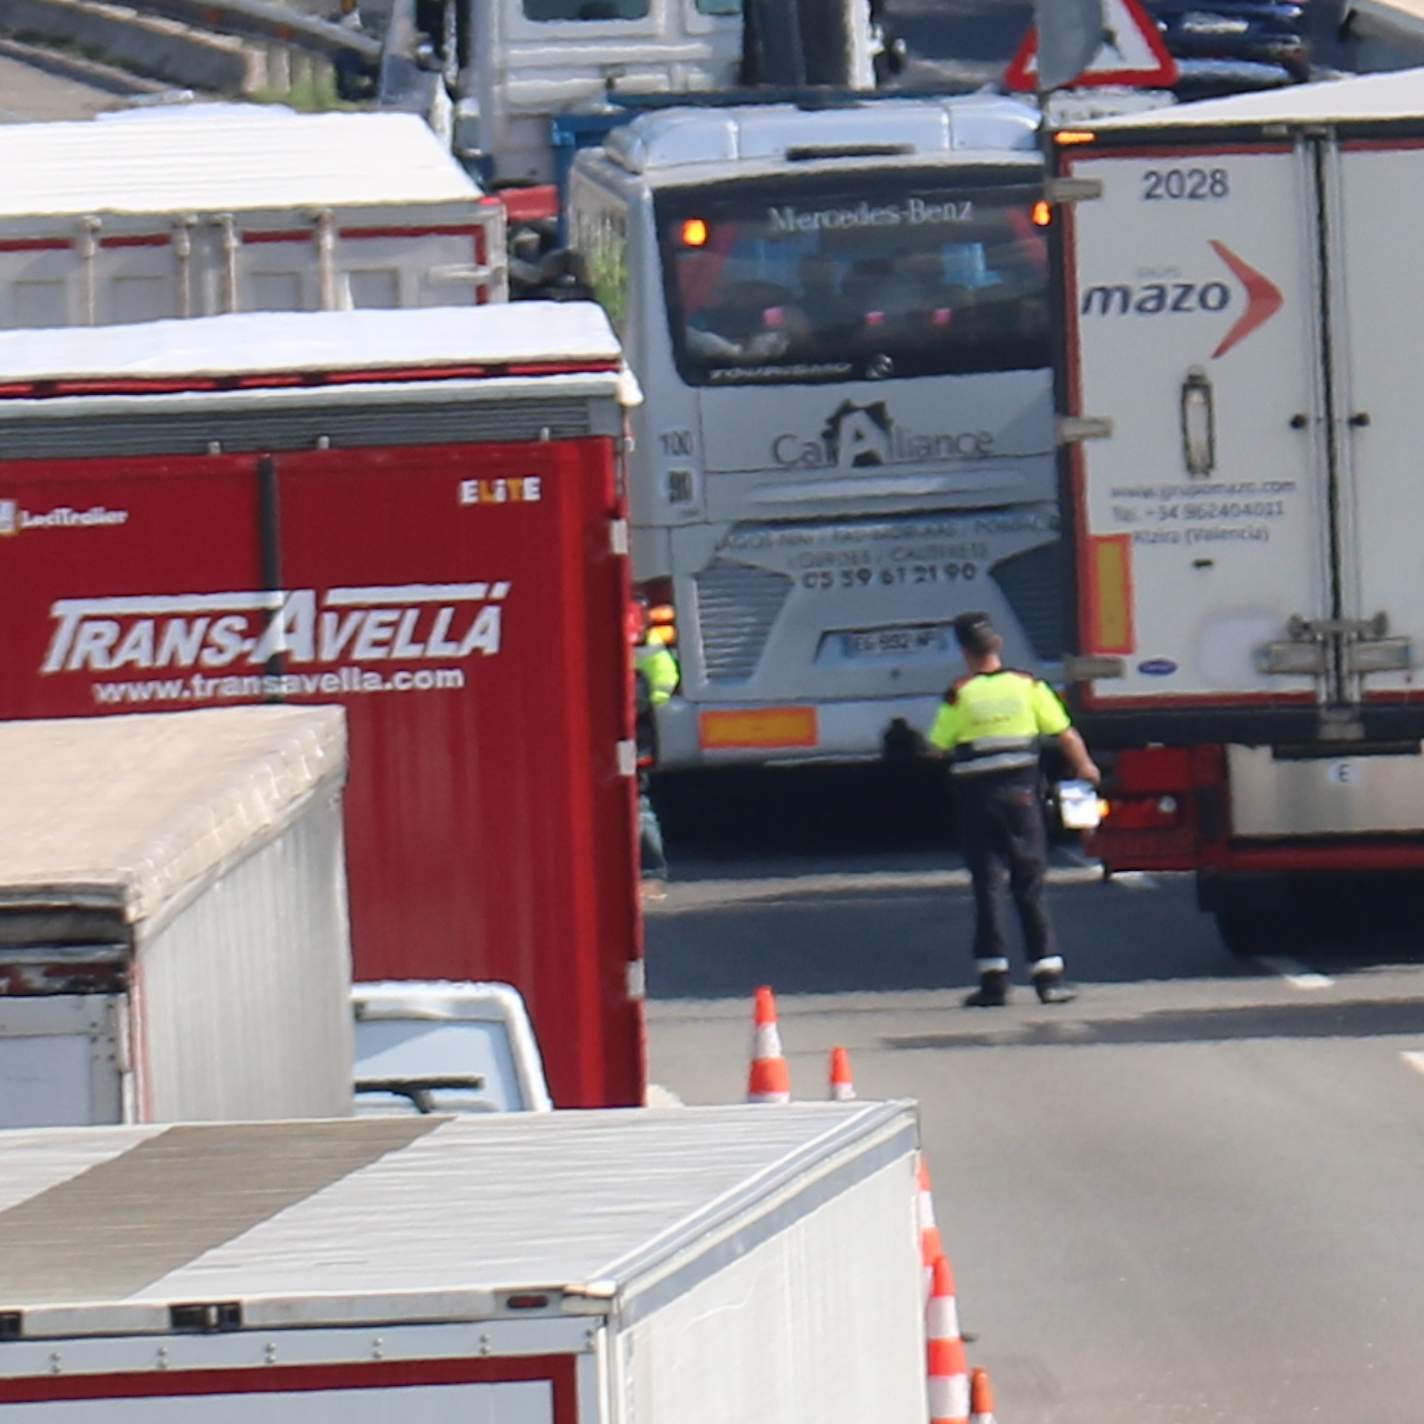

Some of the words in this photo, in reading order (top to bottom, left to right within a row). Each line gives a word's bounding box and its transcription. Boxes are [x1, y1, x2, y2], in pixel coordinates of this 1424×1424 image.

[1143, 169, 1229, 199] 2028
[768, 198, 973, 231] Mercedes-Benz
[1082, 281, 1231, 315] mazo
[660, 429, 692, 456] 100
[841, 569, 871, 587] 59
[881, 567, 906, 585] 61
[915, 565, 937, 584] 21
[947, 563, 977, 581] 90
[93, 666, 464, 703] www.transavella.com
